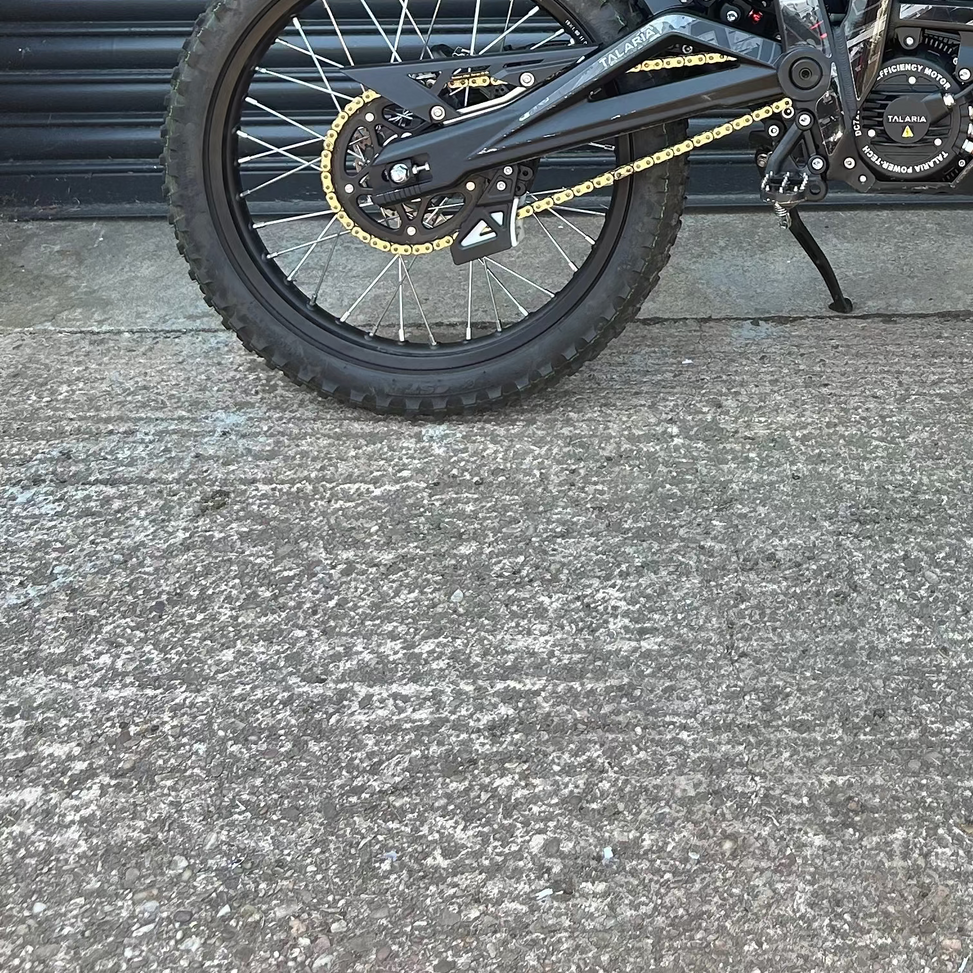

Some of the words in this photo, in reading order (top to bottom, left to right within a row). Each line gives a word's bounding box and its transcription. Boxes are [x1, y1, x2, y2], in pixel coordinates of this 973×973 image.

[599, 28, 656, 69] TALARIA
[923, 67, 952, 90] MOTOR
[887, 115, 927, 123] TALARIA
[861, 145, 913, 174] POWER-TECH
[914, 150, 949, 173] TALARIA
